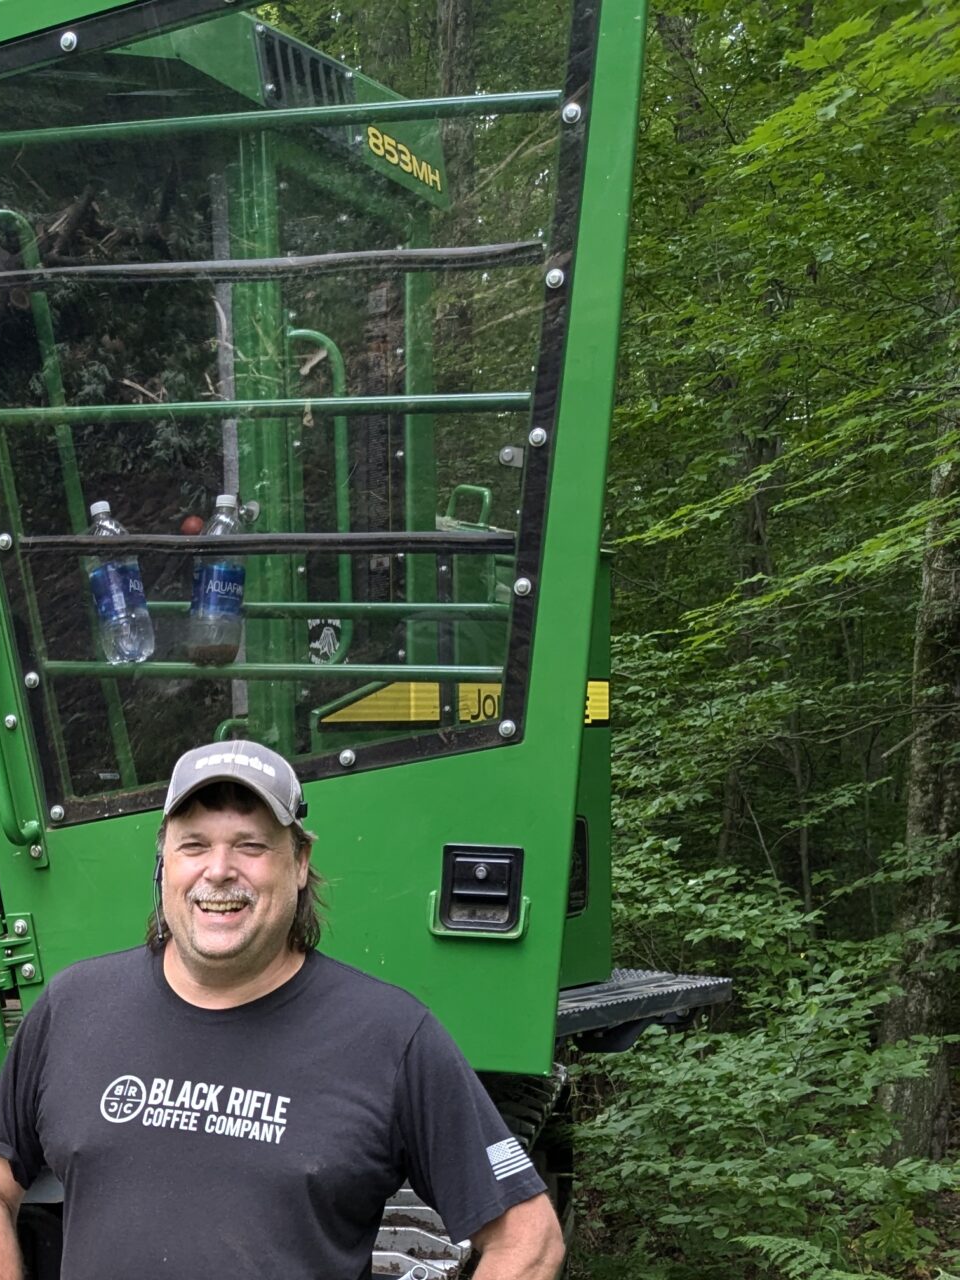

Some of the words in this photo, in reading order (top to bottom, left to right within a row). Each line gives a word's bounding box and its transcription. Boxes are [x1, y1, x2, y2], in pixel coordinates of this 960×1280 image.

[367, 126, 442, 192] 853MH
[149, 1077, 224, 1112] BLACK
[226, 1087, 291, 1125] RIFLE
[142, 1107, 200, 1131] COFFEE
[204, 1114, 286, 1144] COMPANY
